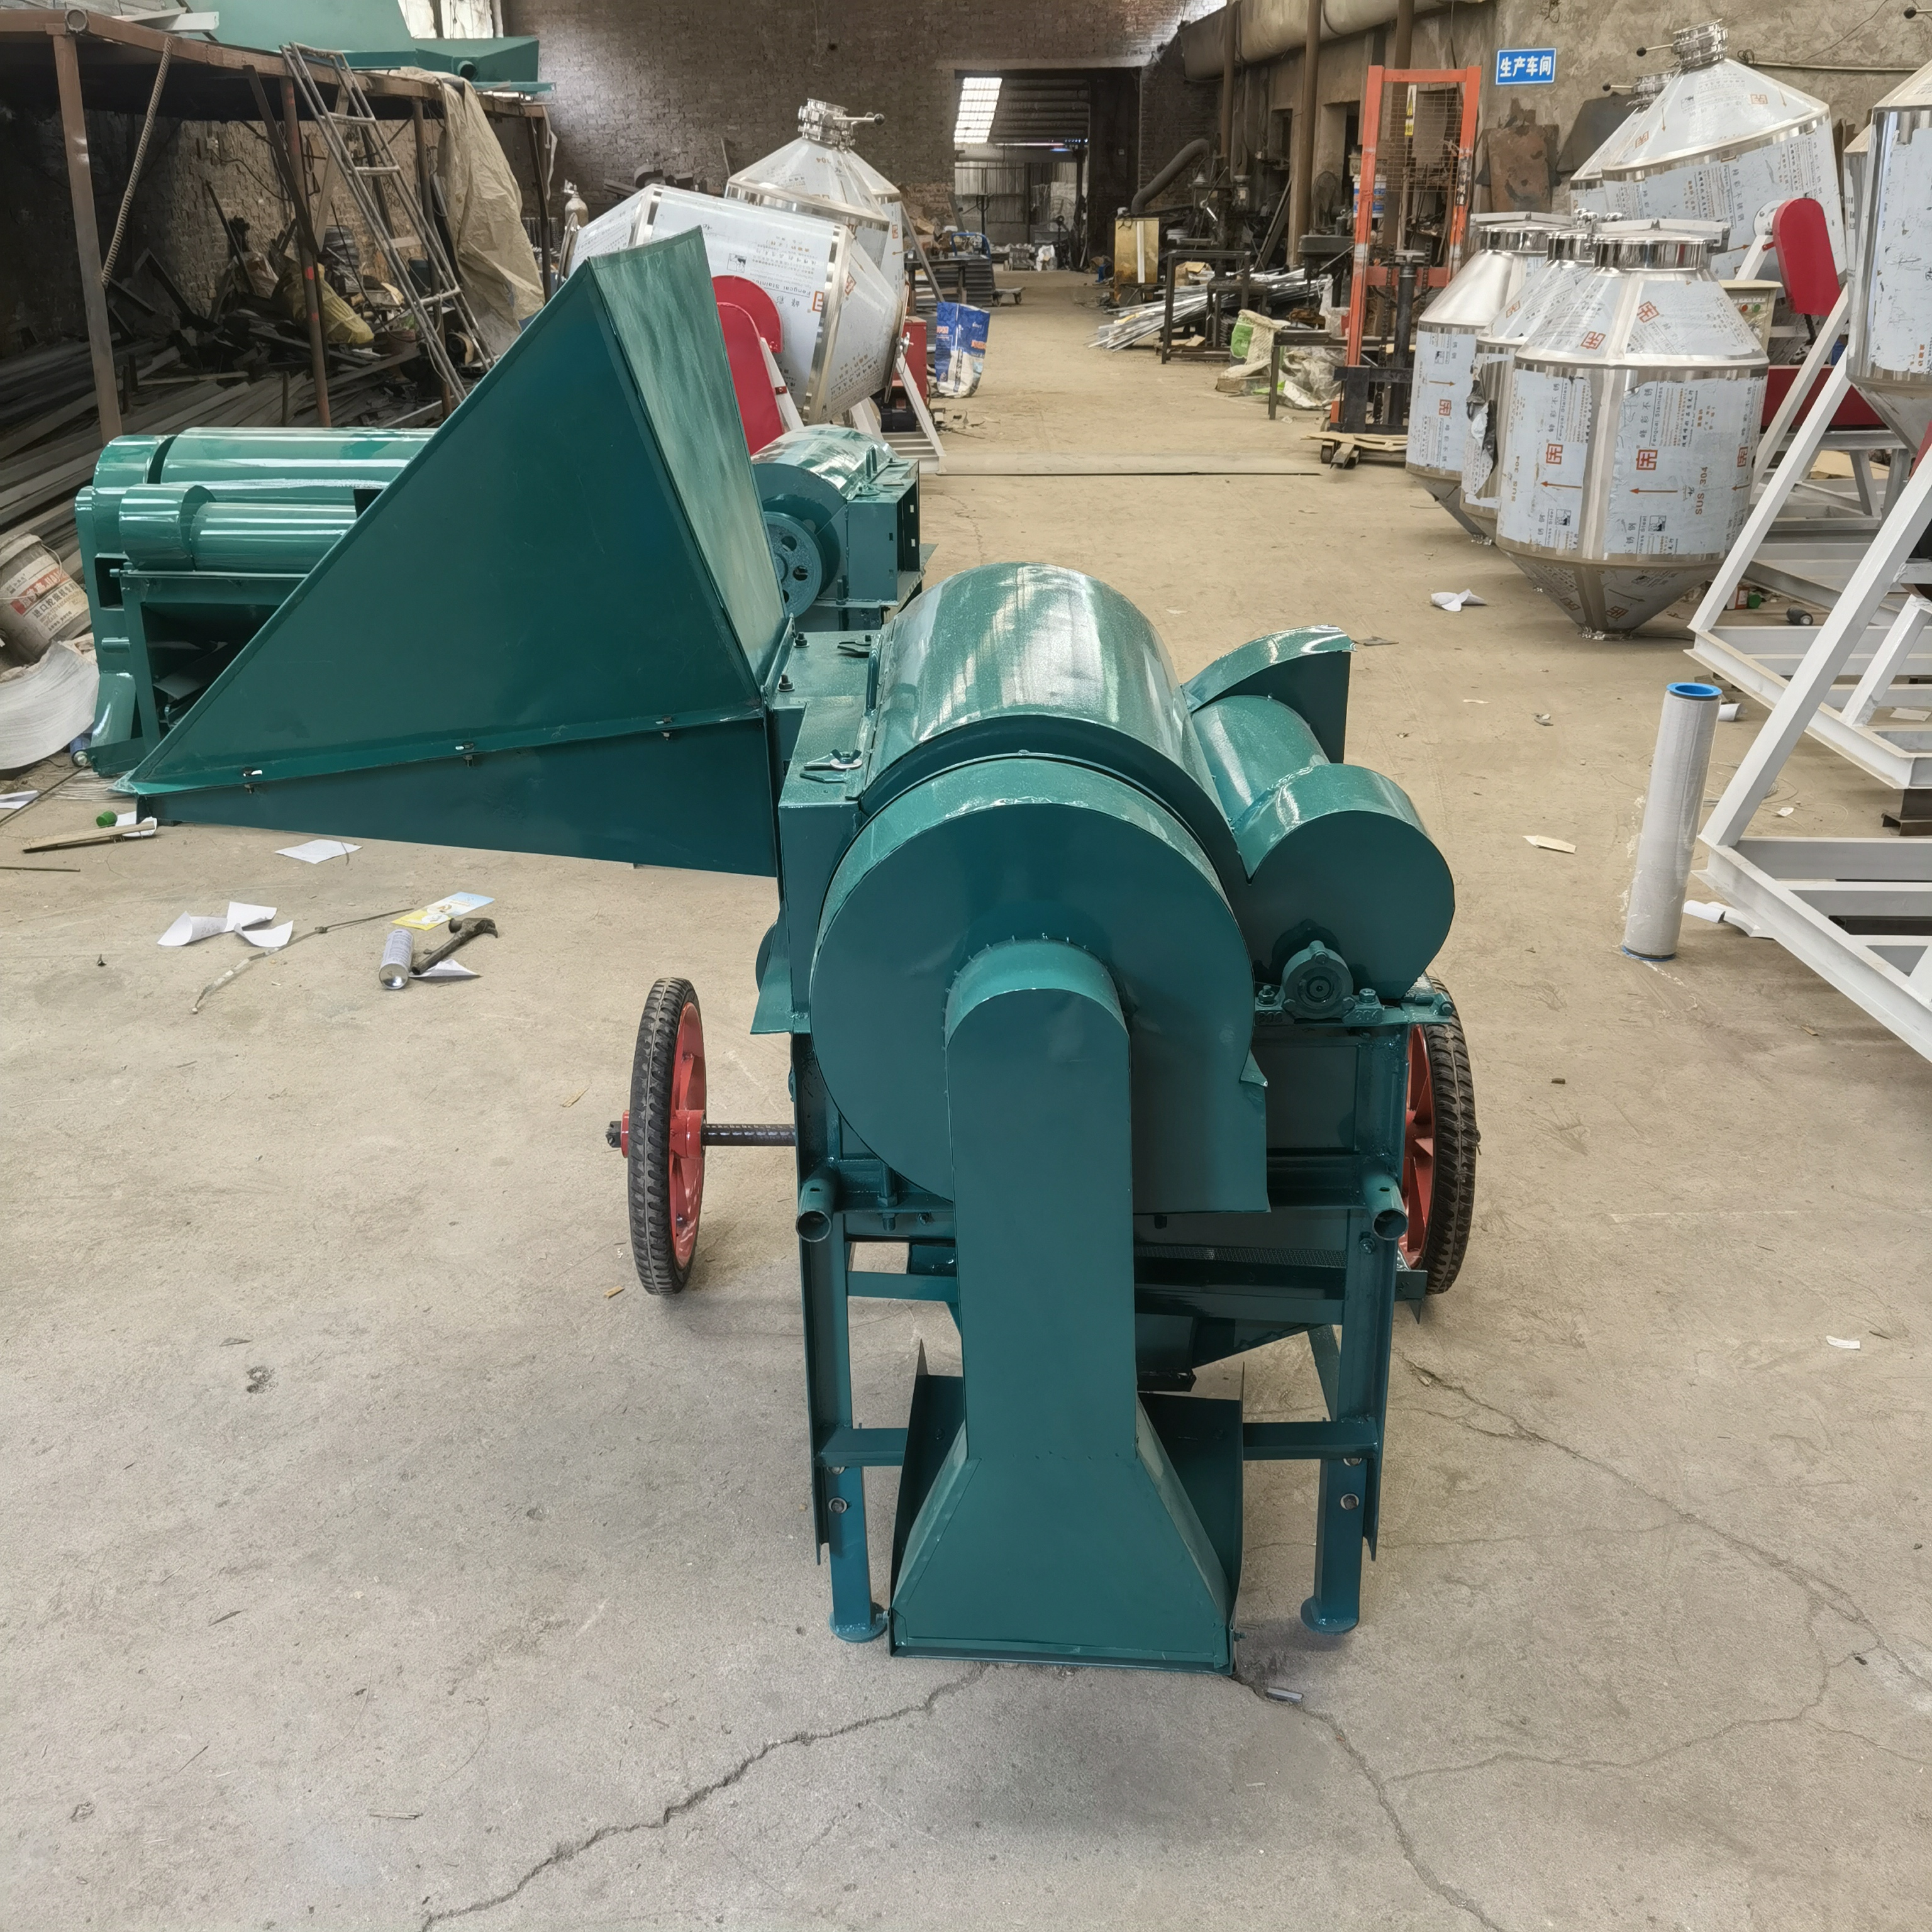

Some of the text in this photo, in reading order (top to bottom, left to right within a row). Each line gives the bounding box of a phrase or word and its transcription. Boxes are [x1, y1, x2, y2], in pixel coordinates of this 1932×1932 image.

[1499, 55, 1552, 77] 生产车间
[1696, 467, 1709, 515] SUS 304
